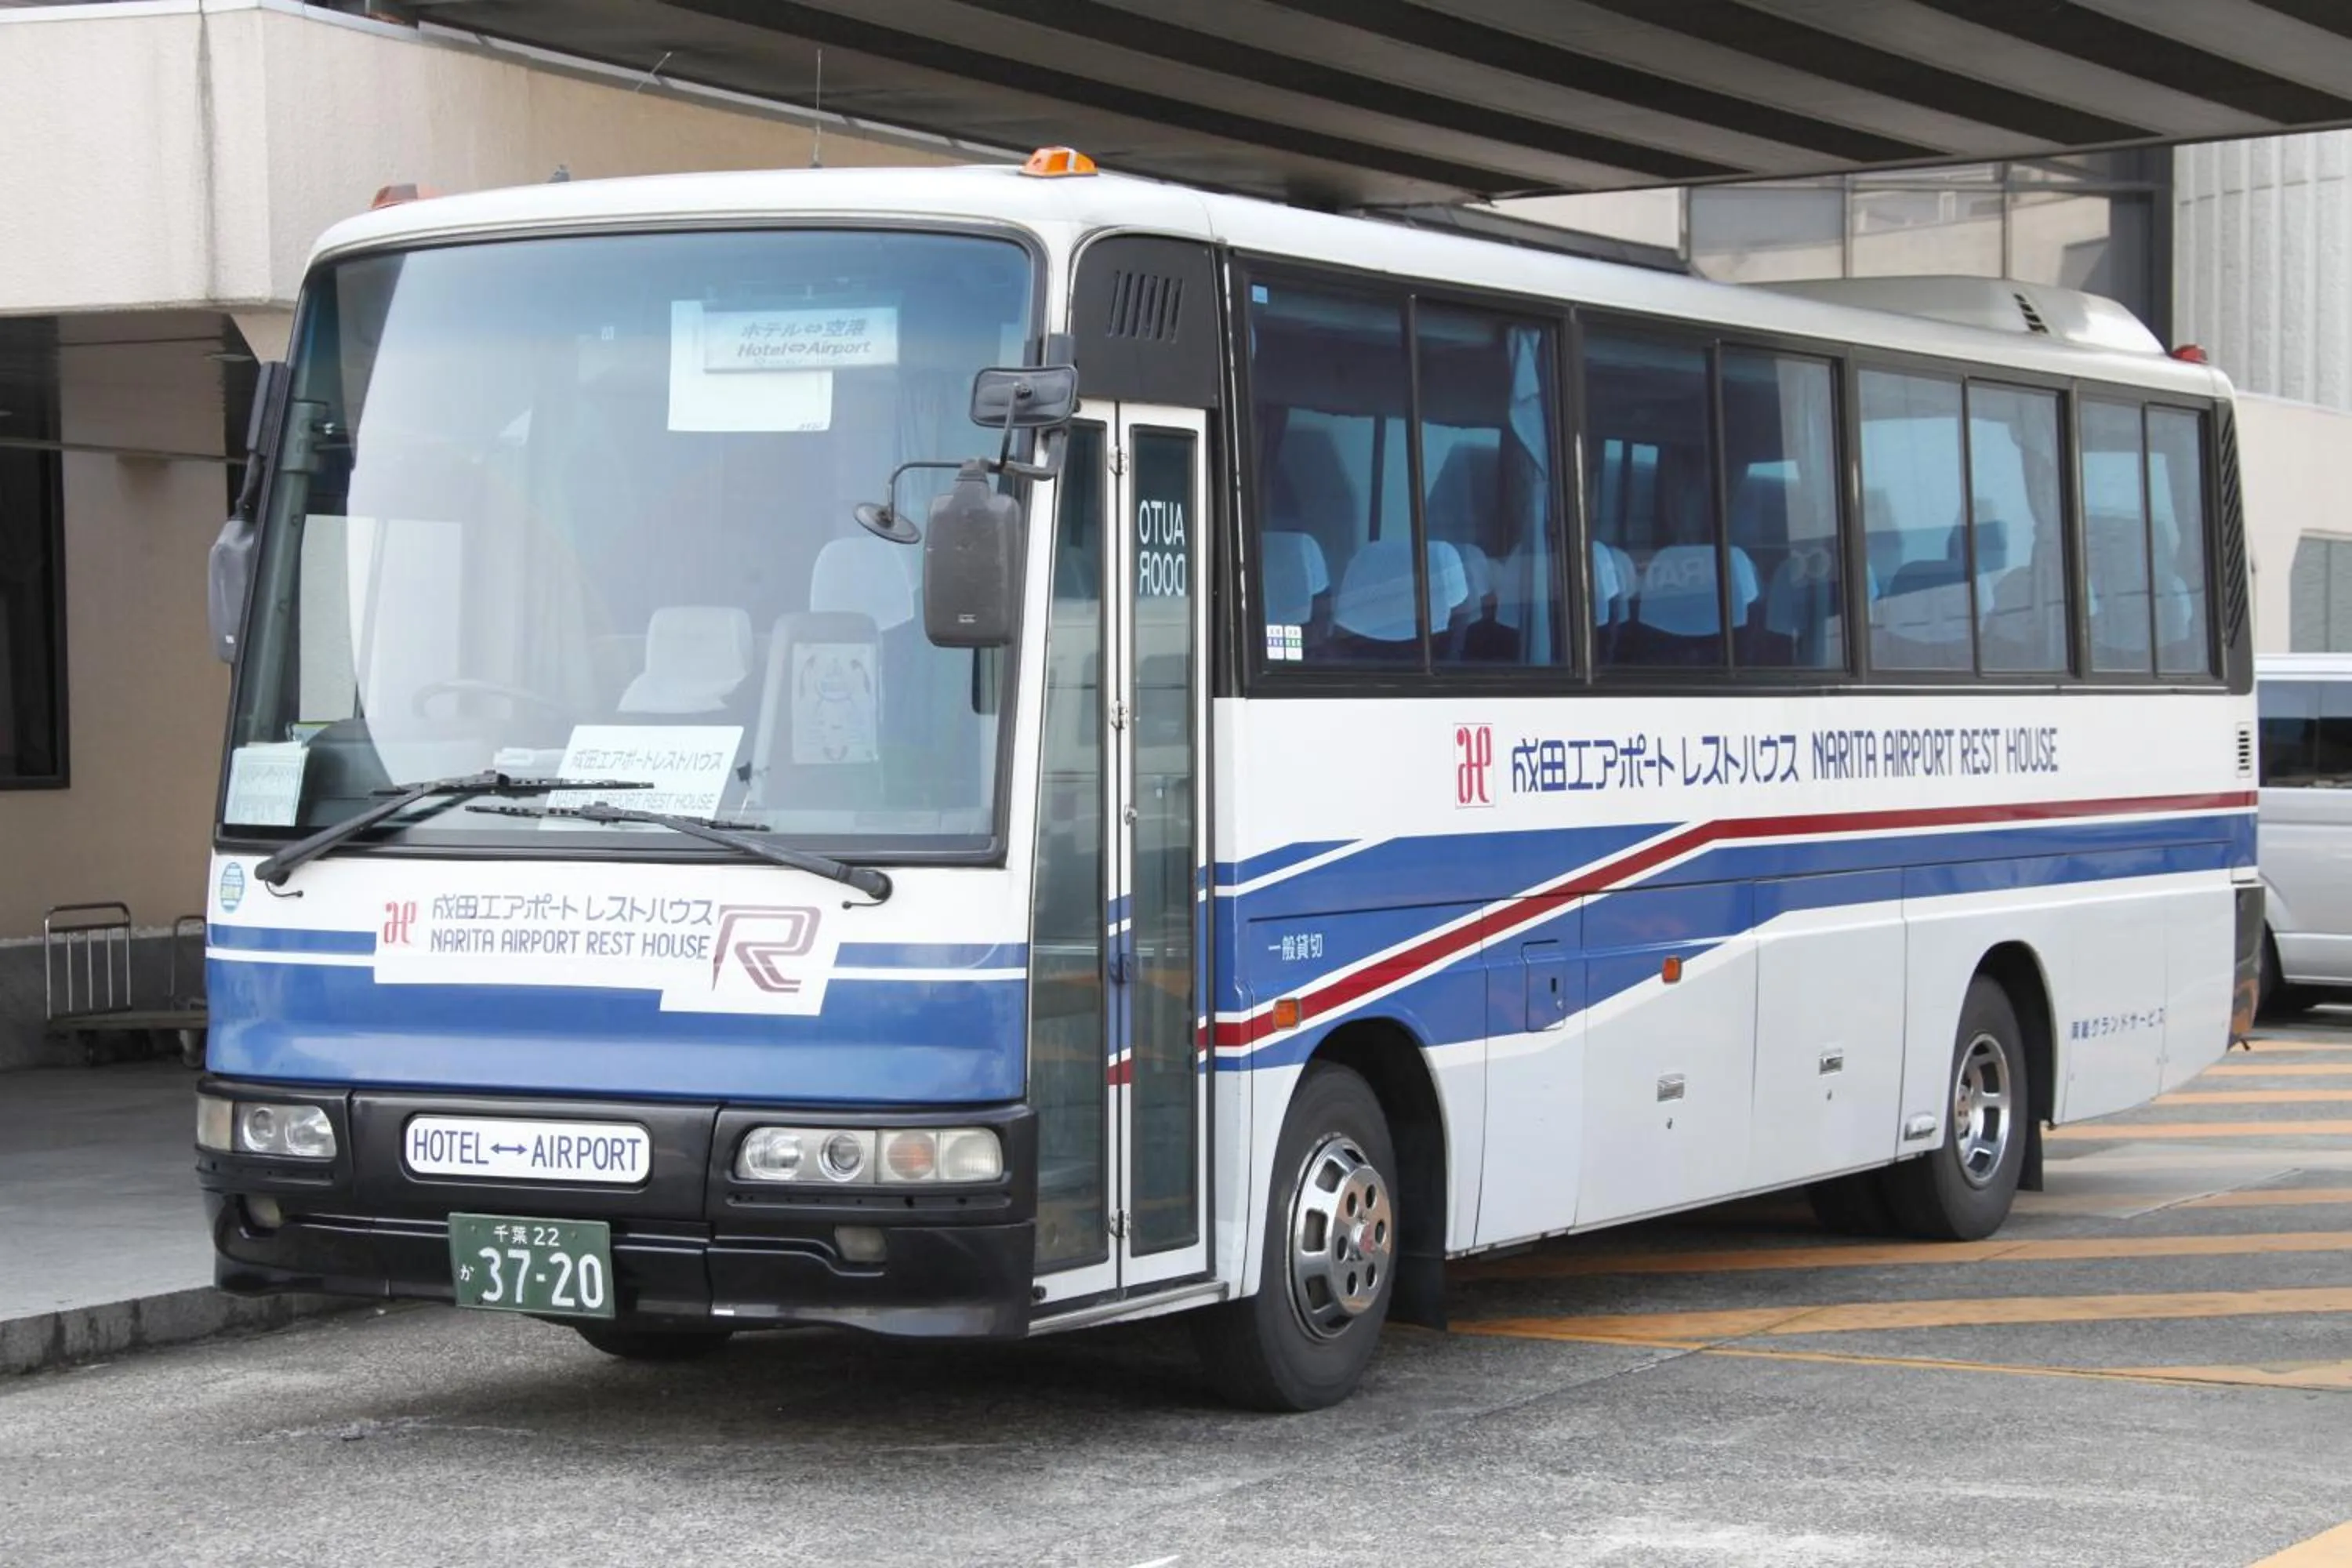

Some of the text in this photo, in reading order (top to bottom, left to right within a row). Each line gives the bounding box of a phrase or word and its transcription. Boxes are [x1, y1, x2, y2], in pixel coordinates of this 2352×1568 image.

[737, 340, 872, 358] Hotel Airport
[1811, 730, 1878, 780] NARITA
[1883, 728, 1955, 777] AIRPORT
[1959, 728, 2000, 775] REST
[2005, 727, 2059, 773] HOUSE
[430, 928, 712, 960] NARITA AIRPORT REST HOUSE
[1267, 932, 1323, 961] 一般貸切
[412, 1128, 642, 1172] HOTEL AIRPORT
[493, 1224, 561, 1247] 千葉 22
[459, 1245, 604, 1309] か 37-20
